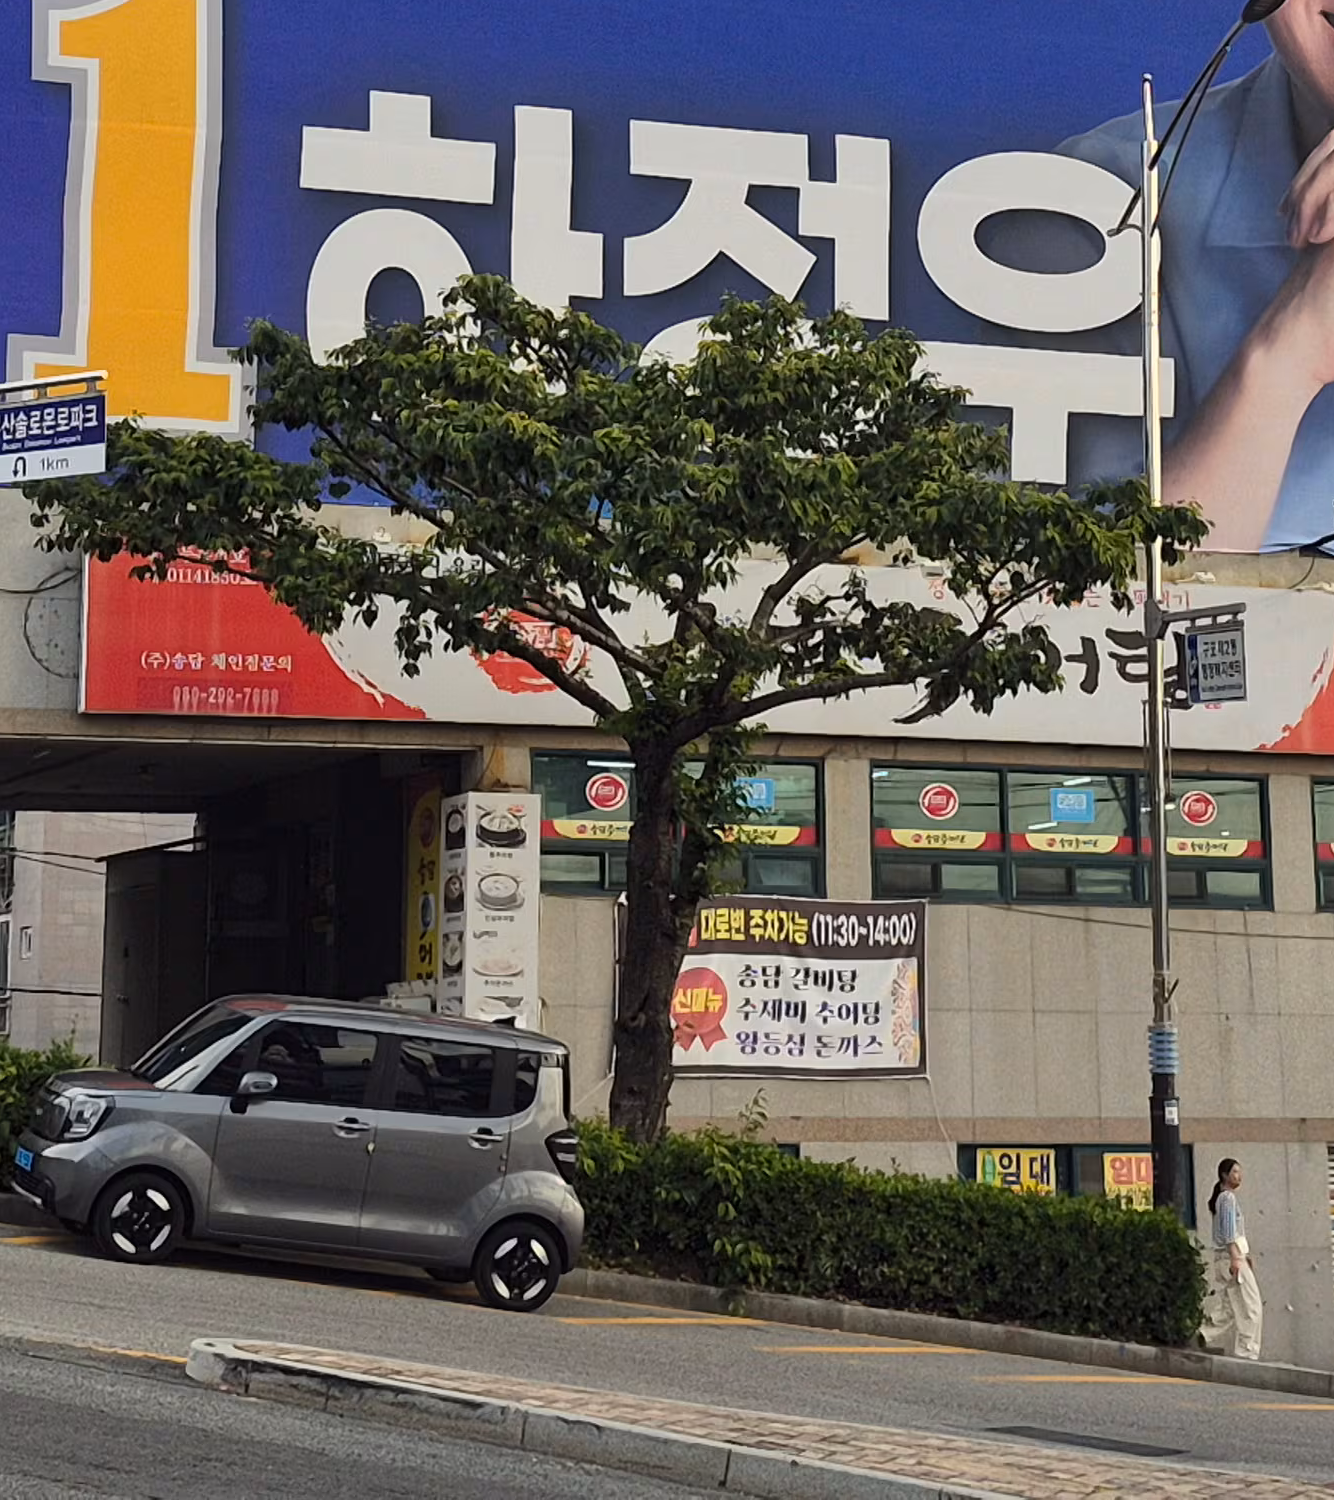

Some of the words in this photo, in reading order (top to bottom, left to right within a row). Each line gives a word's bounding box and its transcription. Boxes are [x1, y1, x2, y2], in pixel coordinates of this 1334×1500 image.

[300, 90, 1175, 487] 하정우
[39, 457, 69, 472] 1km
[141, 650, 205, 671] (주)송담
[210, 652, 292, 673] 체인점문의
[700, 907, 746, 941] 대로변
[749, 908, 809, 946] 주차가능
[811, 911, 916, 948] (11:30~14:00)
[737, 964, 783, 991] 송담
[789, 966, 858, 994] 갈비탕
[736, 998, 808, 1024] 수제비
[815, 1000, 882, 1027] 추어탕
[735, 1030, 806, 1058] 왕등심
[814, 1033, 884, 1060] 돈까스
